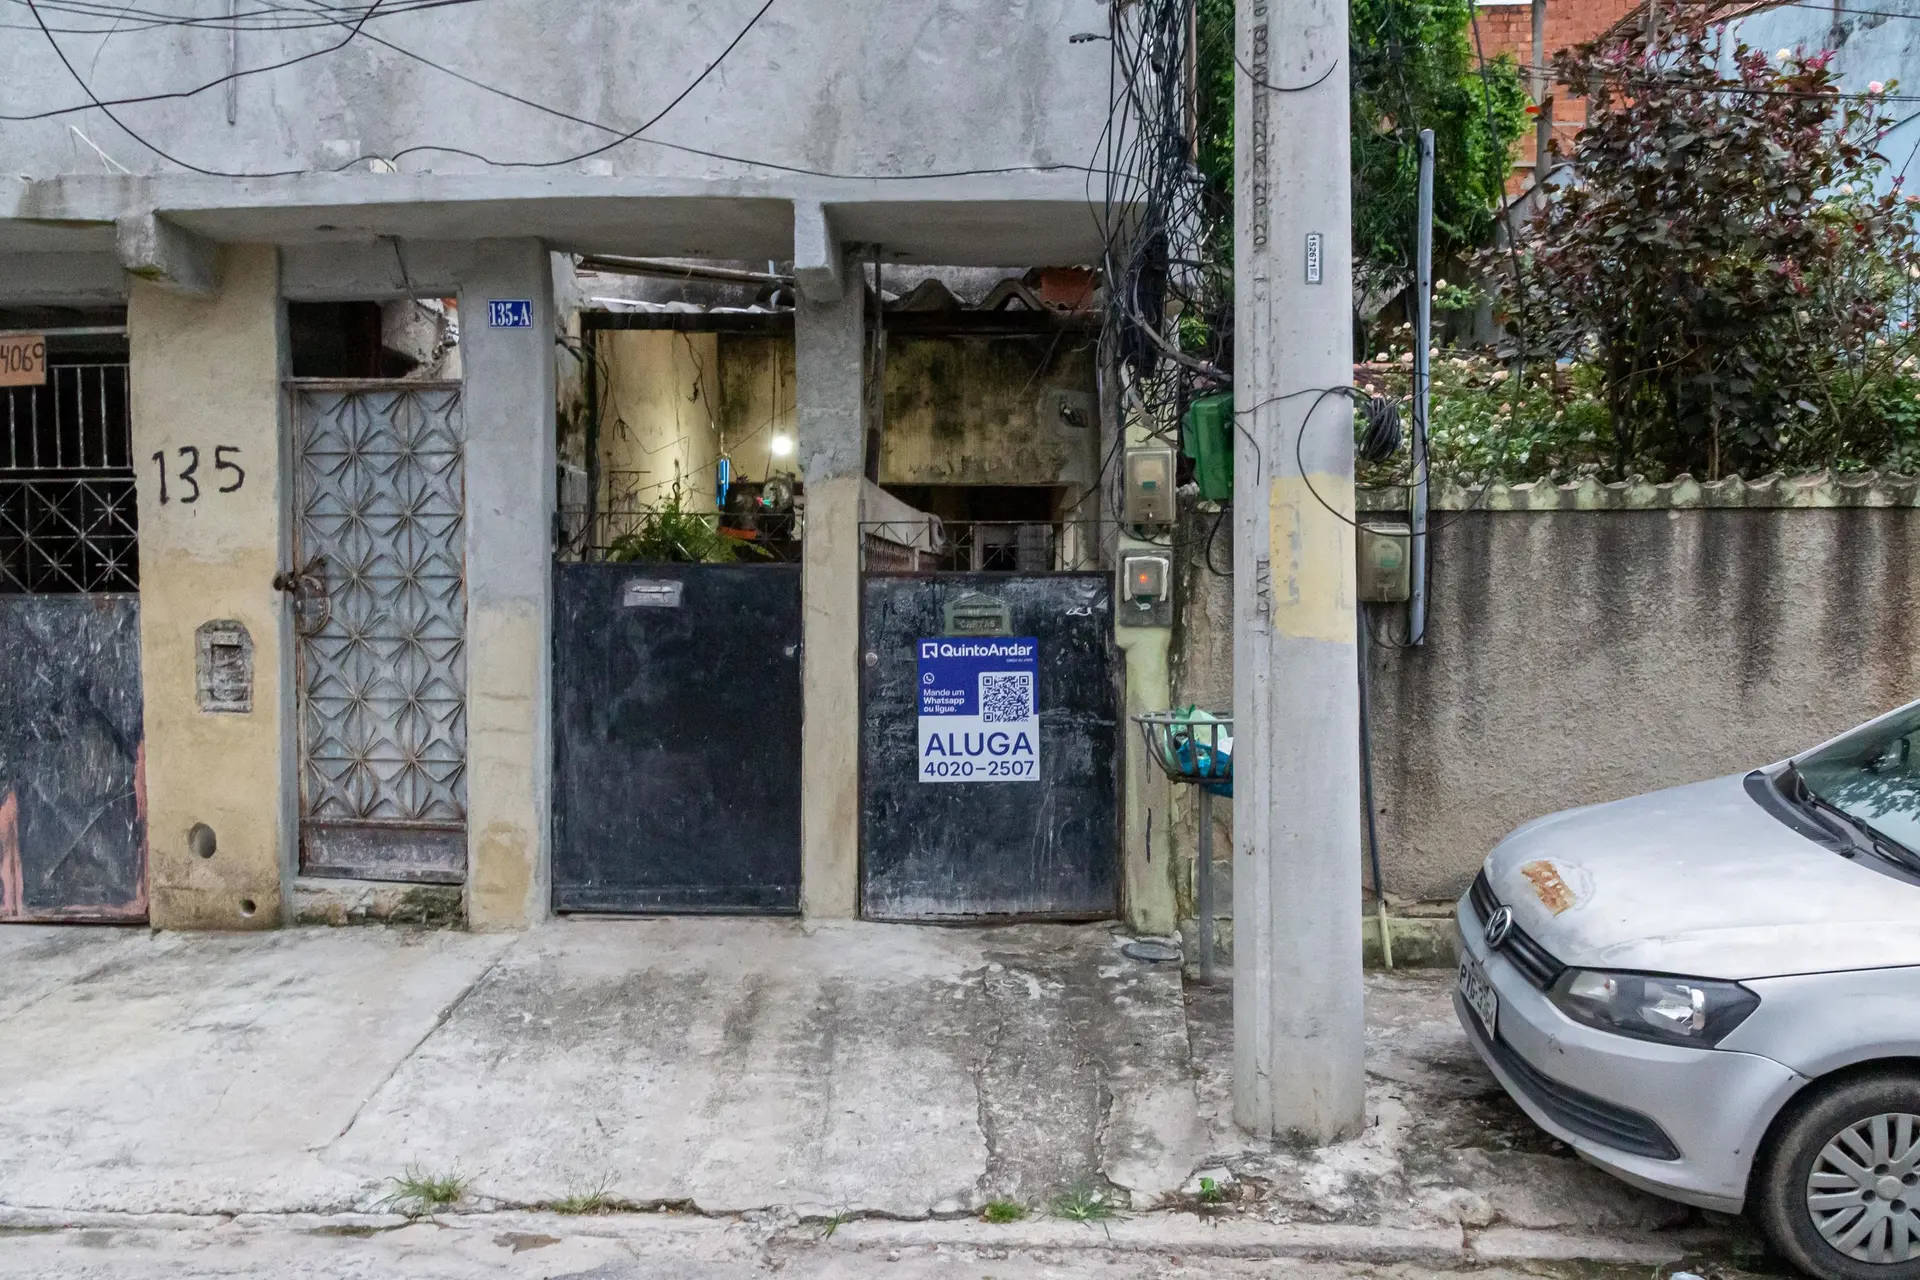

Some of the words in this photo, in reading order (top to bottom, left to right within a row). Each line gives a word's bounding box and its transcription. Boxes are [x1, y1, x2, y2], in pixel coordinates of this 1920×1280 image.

[1308, 236, 1317, 268] 152671
[490, 302, 530, 326] 135-A
[0, 342, 45, 374] 4069
[151, 444, 246, 506] 135
[940, 643, 1033, 657] QuintoAndar
[923, 697, 965, 705] Whatsapp
[935, 705, 957, 714] ligue.
[924, 732, 1034, 757] ALUGA
[924, 760, 1034, 777] 4020-2507
